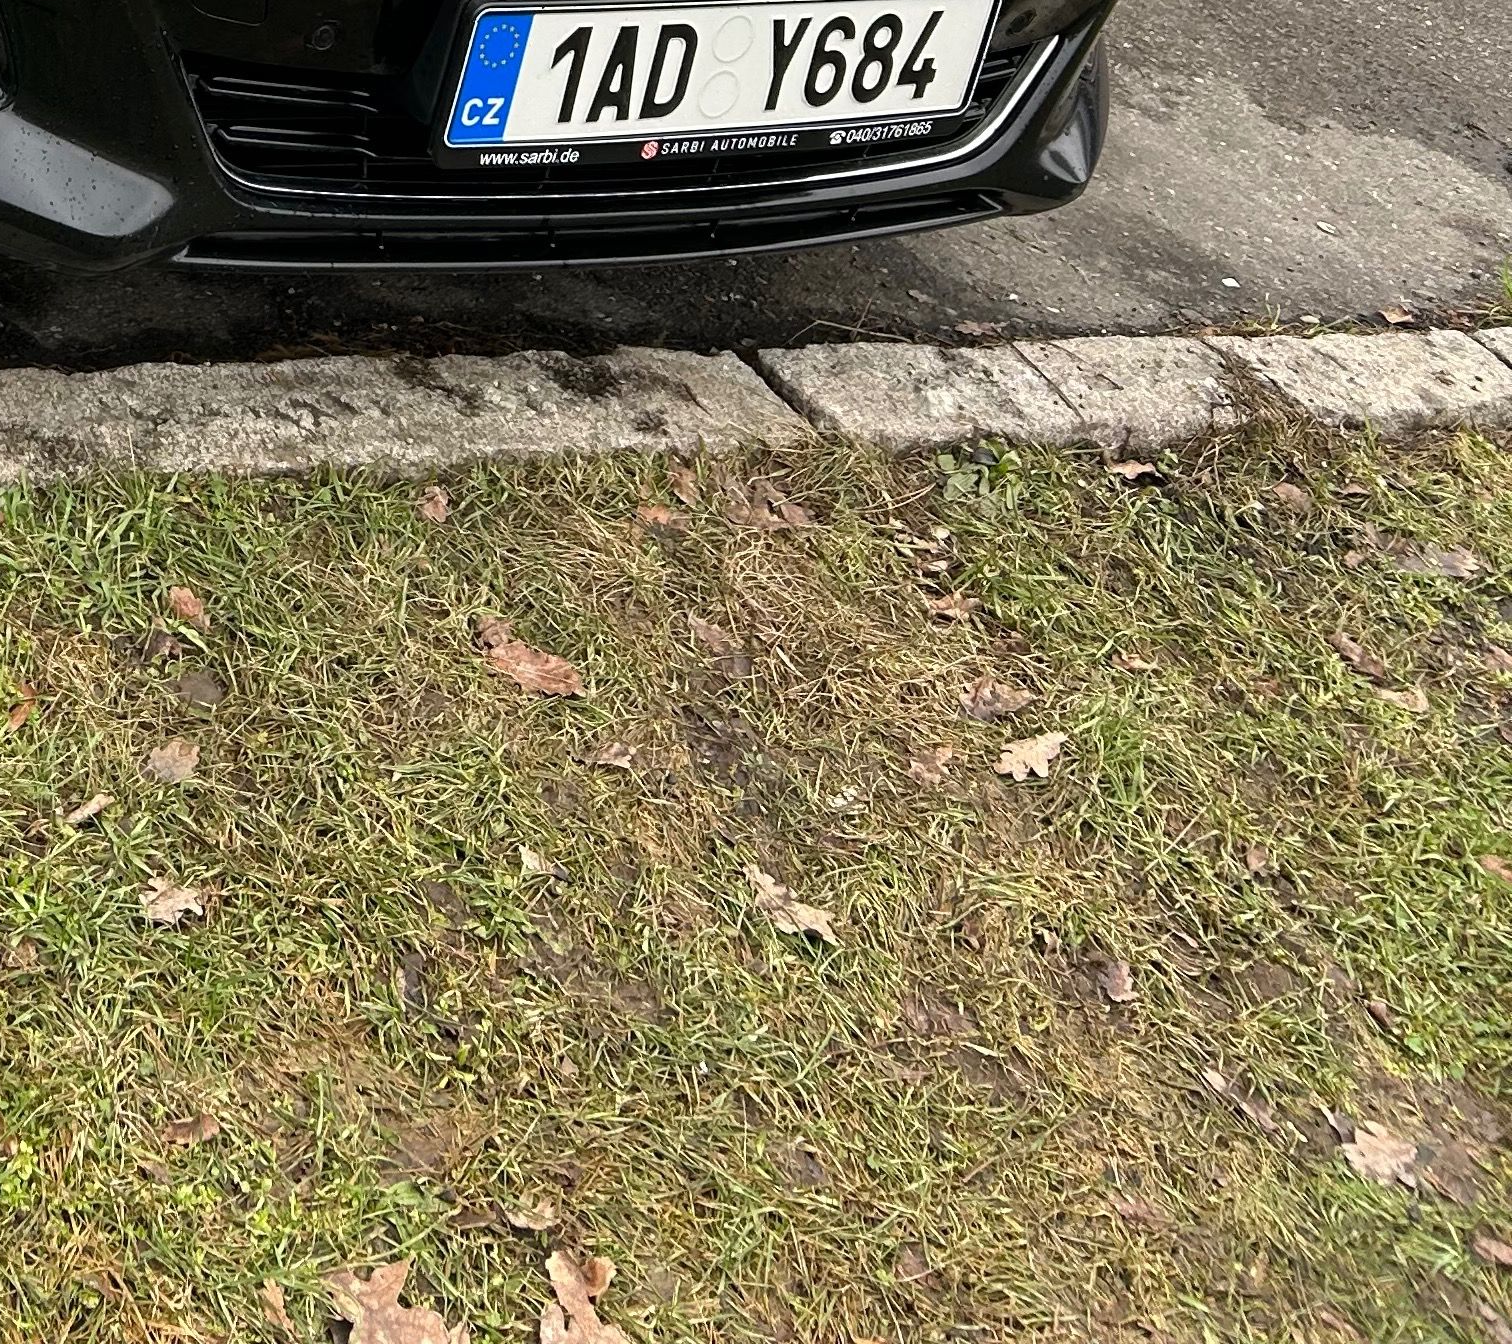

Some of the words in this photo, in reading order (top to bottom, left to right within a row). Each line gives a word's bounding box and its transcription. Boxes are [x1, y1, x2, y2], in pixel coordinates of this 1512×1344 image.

[550, 23, 698, 123] 1AD
[765, 10, 944, 111] Y684
[461, 97, 505, 127] CZ
[479, 148, 580, 166] www.sarbi.de
[661, 141, 705, 155] SARBI
[710, 134, 799, 151] AUTOMOBILE
